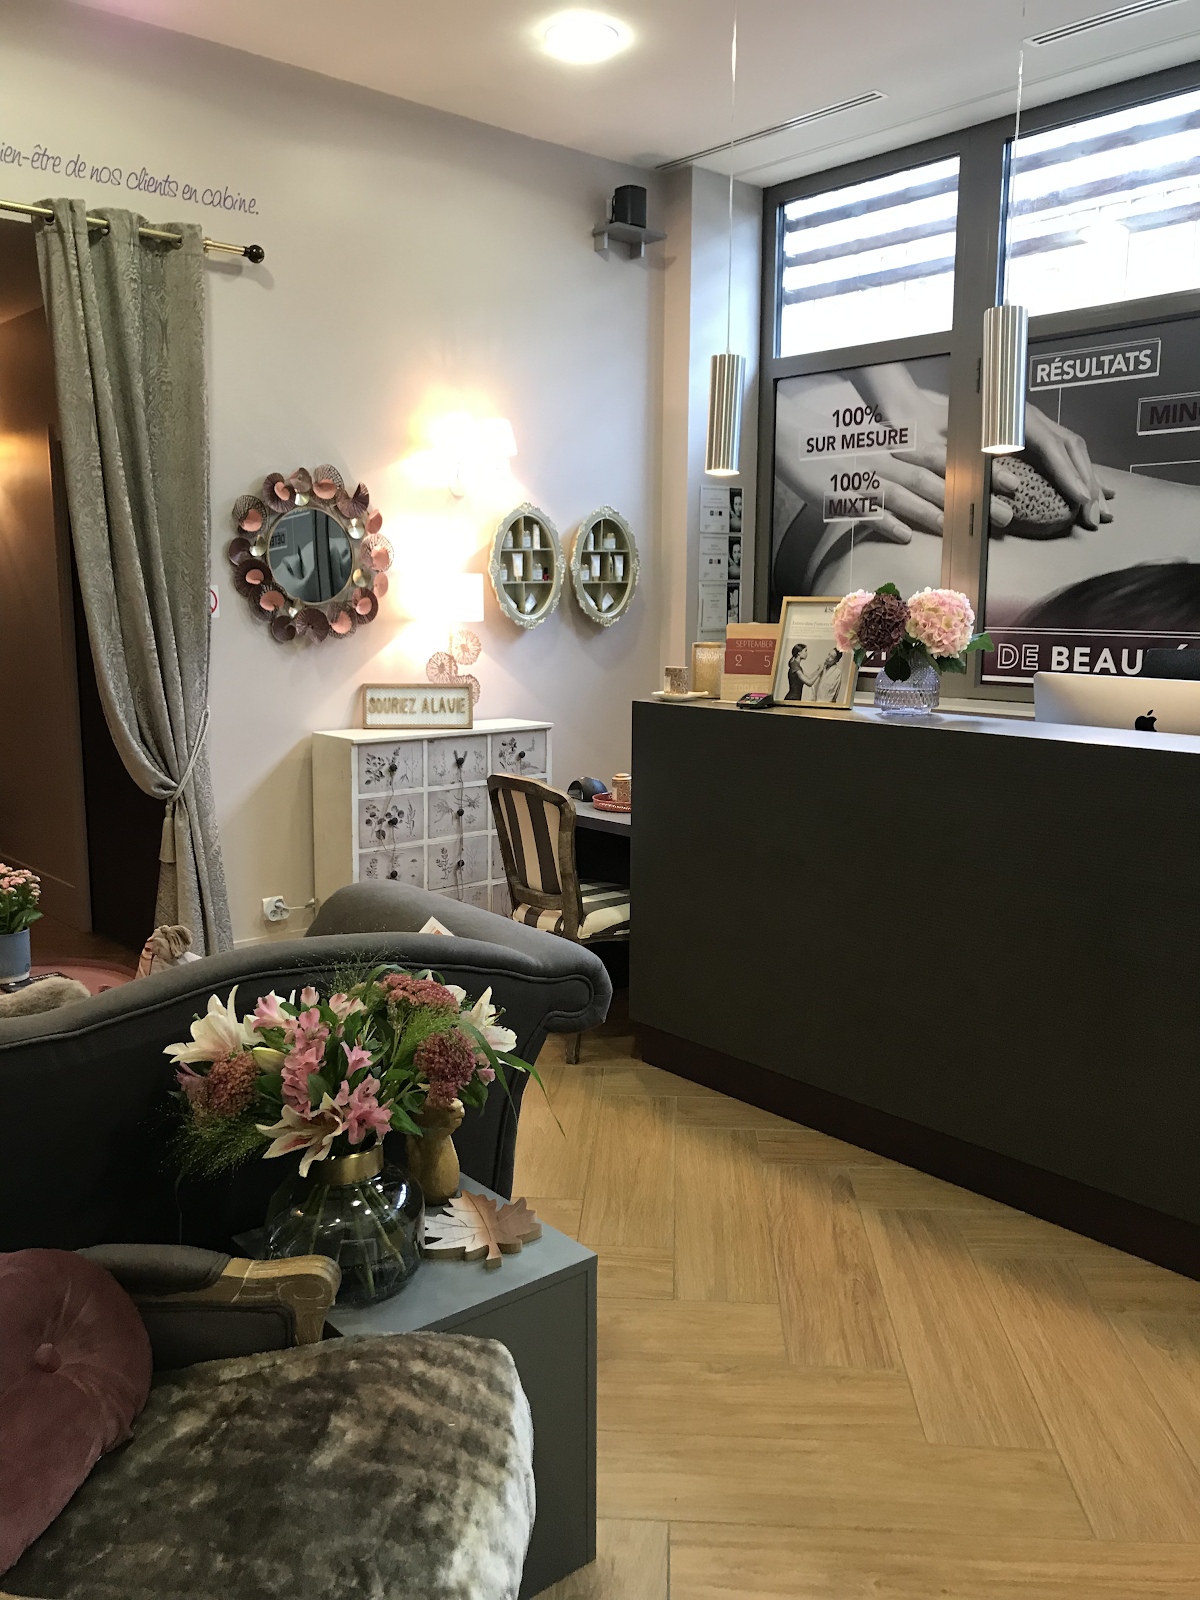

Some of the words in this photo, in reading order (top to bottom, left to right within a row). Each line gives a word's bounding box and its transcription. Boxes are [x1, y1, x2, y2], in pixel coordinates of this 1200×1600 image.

[0, 143, 61, 174] ien-être
[65, 154, 87, 179] de
[90, 164, 123, 187] nos
[126, 167, 179, 198] clients
[182, 184, 199, 204] en
[202, 186, 260, 216] cabine.
[1036, 349, 1152, 383] RÉSULTATS
[832, 404, 883, 428] 100%
[1150, 402, 1200, 425] MIN
[806, 435, 836, 454] SUR
[841, 428, 909, 450] MESURE
[830, 471, 880, 492] 100%
[828, 496, 878, 515] MIXTE
[735, 640, 774, 648] SEPTEMBER
[735, 654, 743, 667] 2
[763, 655, 771, 668] 5
[997, 643, 1039, 671] DE
[1051, 644, 1188, 676] BEAU
[368, 697, 417, 714] SOURIEZ
